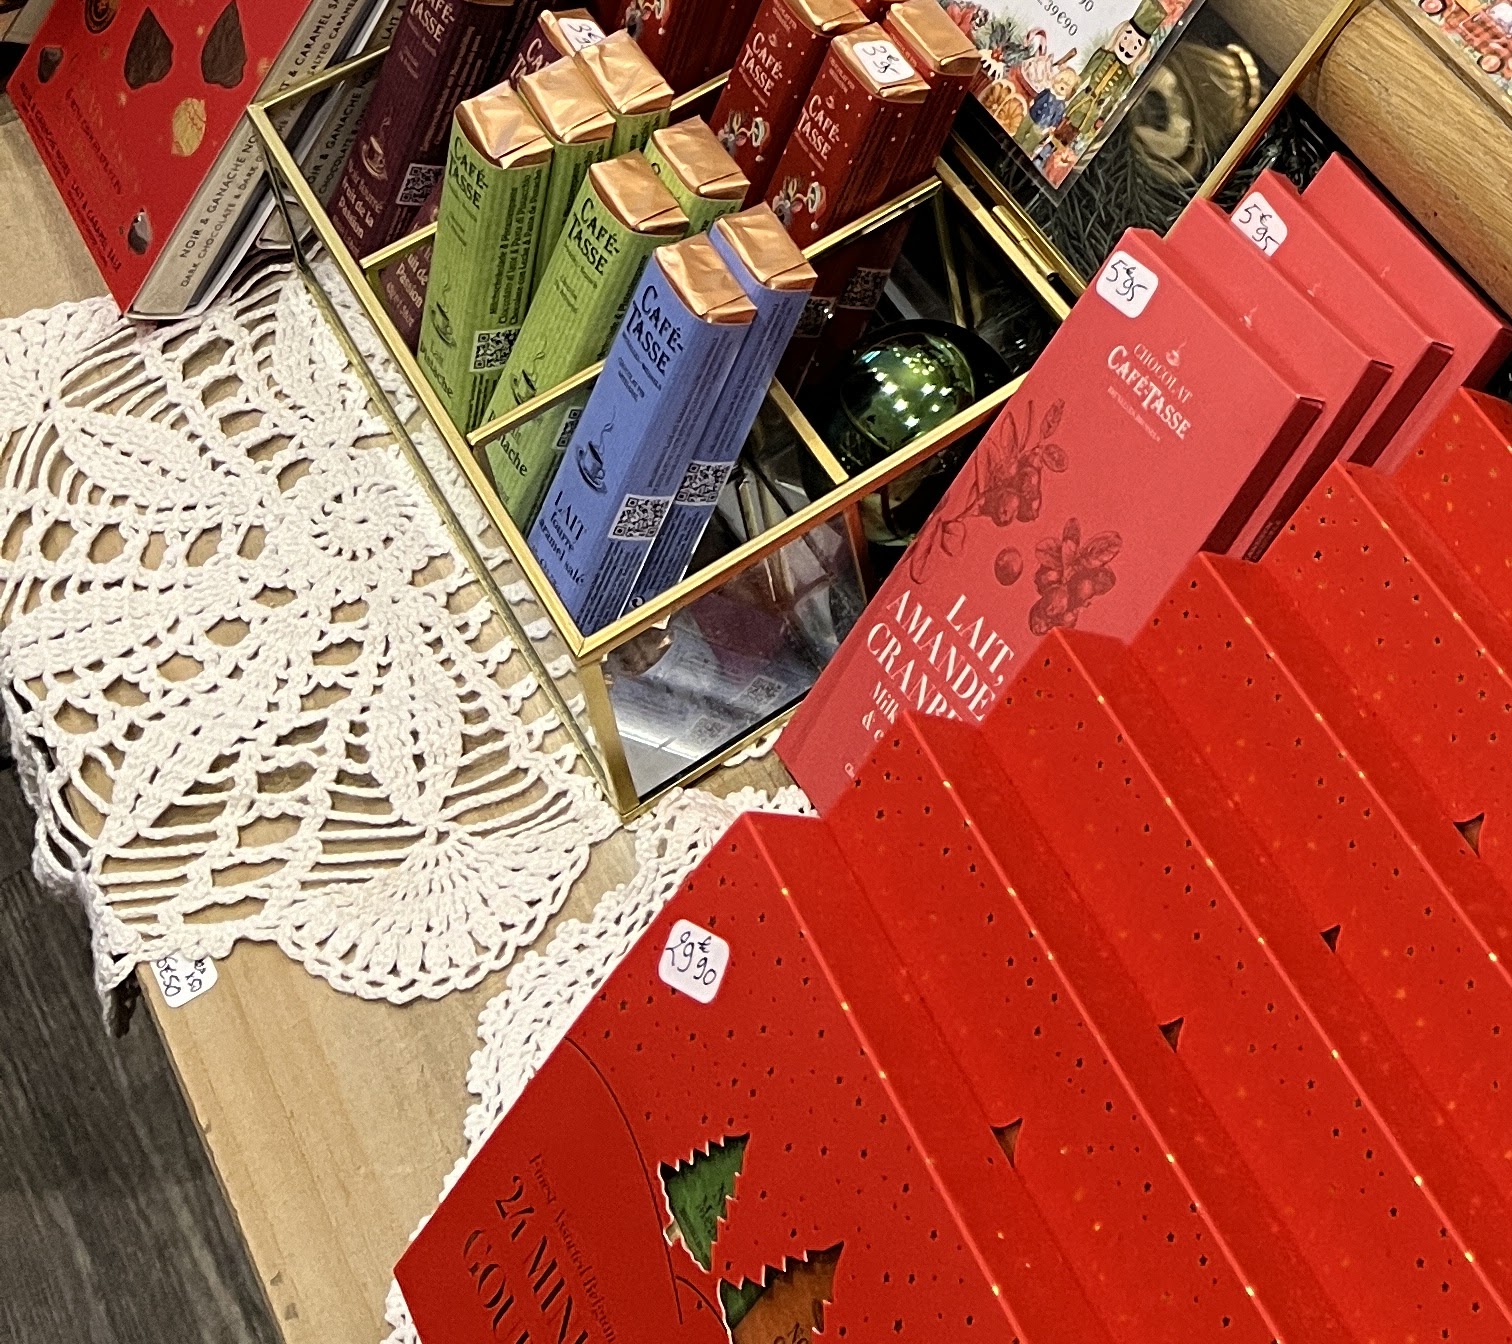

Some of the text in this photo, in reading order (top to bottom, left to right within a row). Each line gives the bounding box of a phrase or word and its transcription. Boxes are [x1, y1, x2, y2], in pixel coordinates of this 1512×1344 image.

[293, 12, 333, 66] CARAMEL
[1044, 0, 1078, 36] 39€90
[740, 44, 774, 97] TASSE
[797, 107, 831, 161] TASSE
[179, 156, 247, 258] NOIR GANACHE
[450, 156, 481, 211] TASSE
[196, 202, 237, 259] CHOCOLATE
[571, 211, 607, 277] TASSE
[626, 302, 671, 376] TASSE
[640, 284, 685, 354] CAFÉ-
[1133, 342, 1193, 403] CHOCOLAT
[553, 491, 585, 540] LAIT
[892, 590, 997, 720] AMANDE
[944, 594, 1016, 686] LAIT,
[871, 681, 900, 723] Milk
